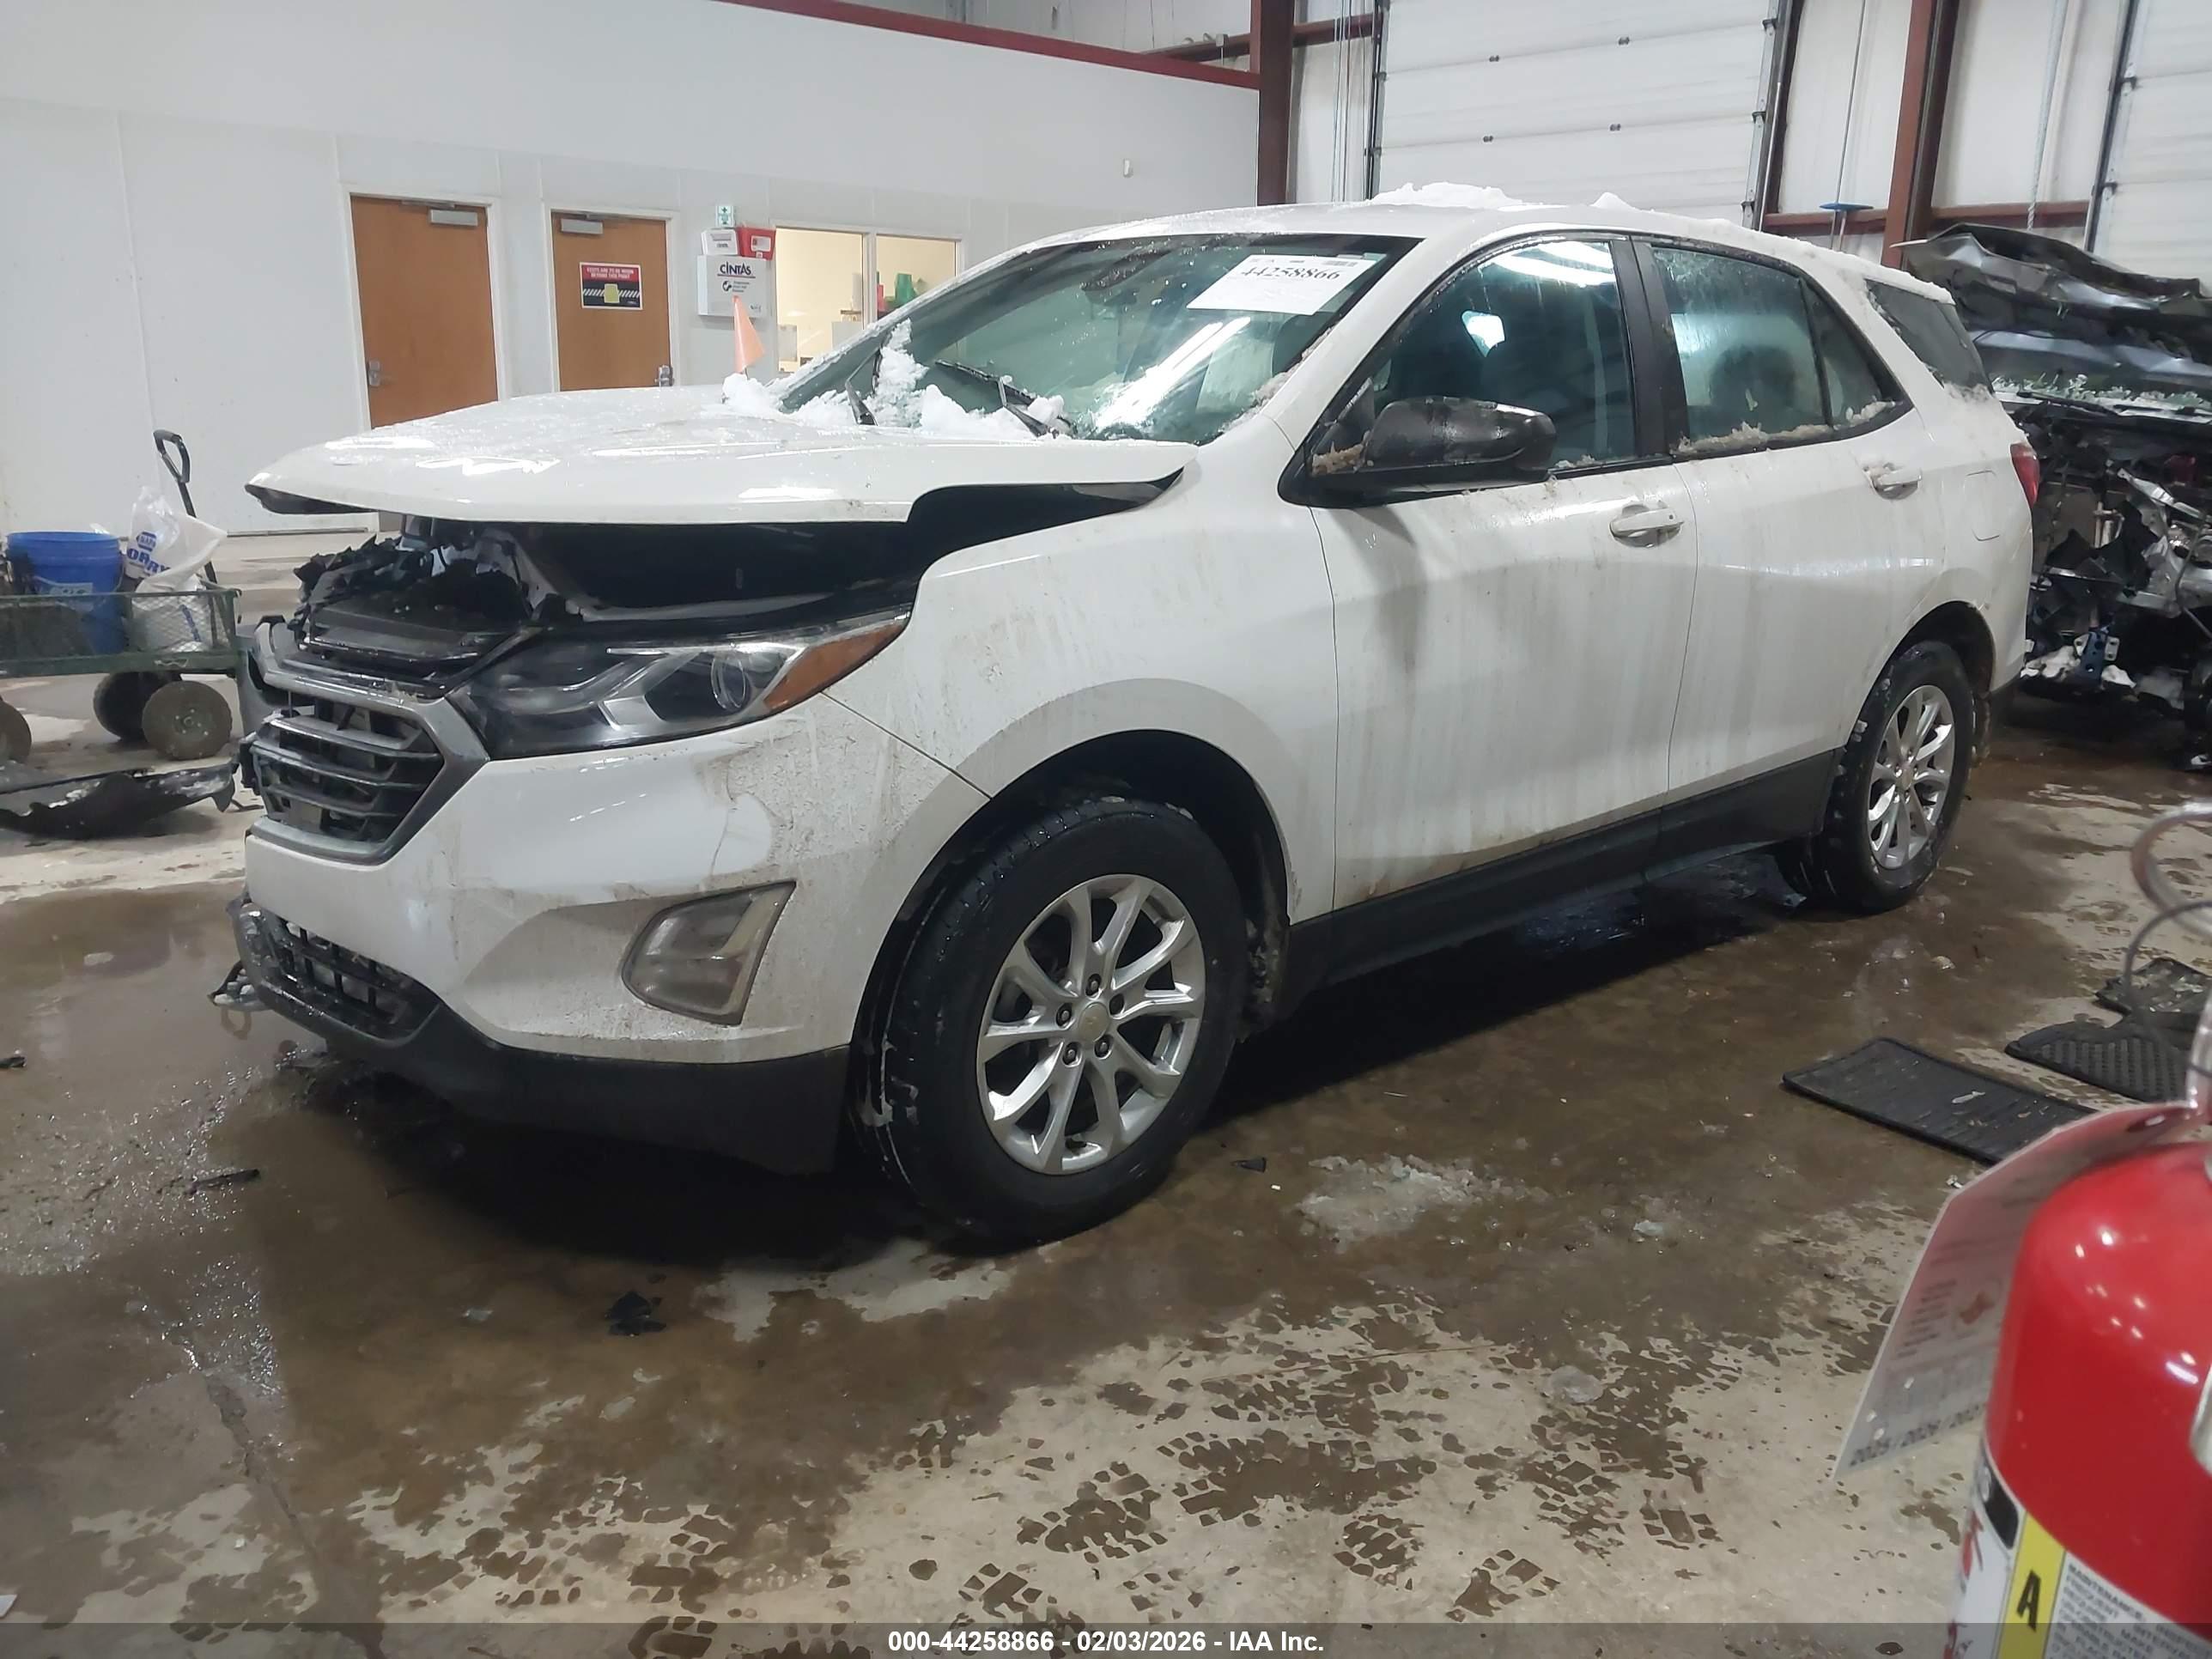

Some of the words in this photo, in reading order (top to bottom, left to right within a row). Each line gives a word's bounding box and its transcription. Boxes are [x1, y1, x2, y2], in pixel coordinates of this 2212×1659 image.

[720, 261, 752, 276] CINTAS
[1241, 266, 1340, 280] 44258866
[2016, 1570, 2041, 1632] A
